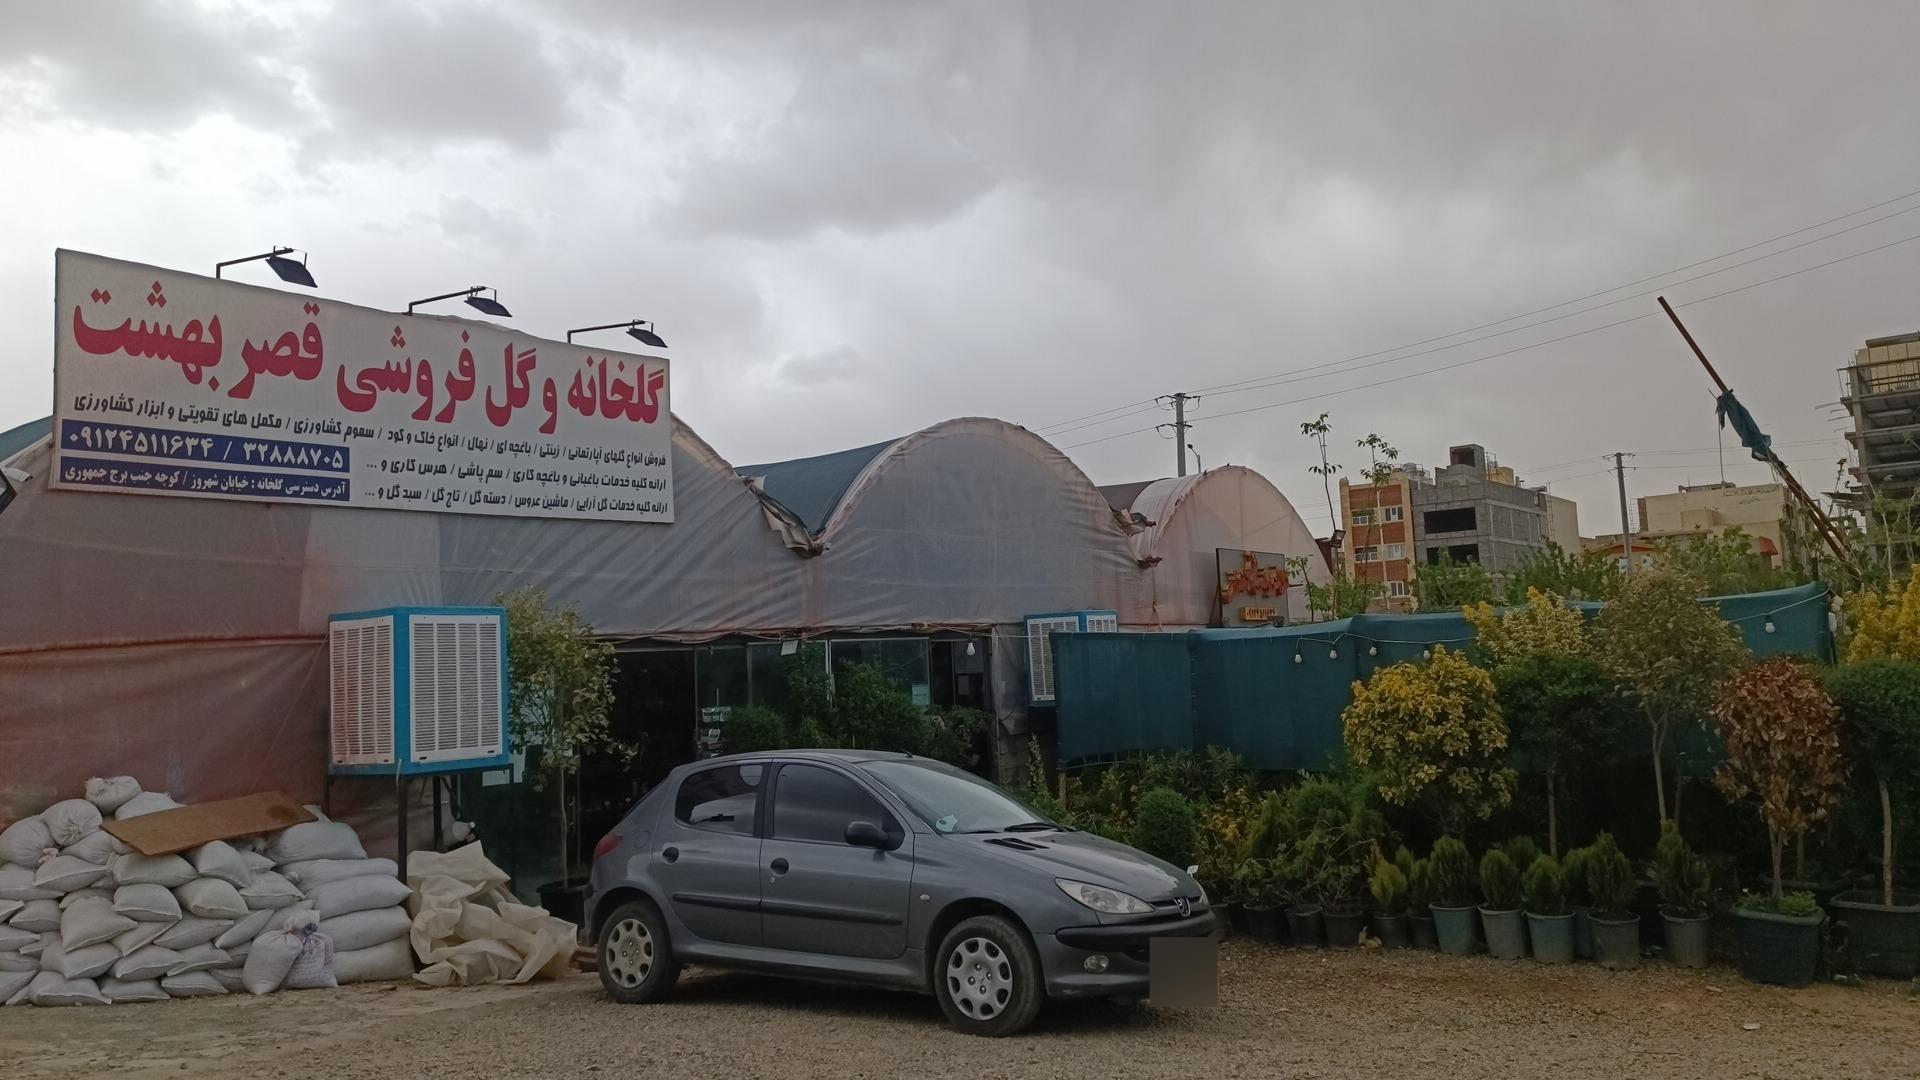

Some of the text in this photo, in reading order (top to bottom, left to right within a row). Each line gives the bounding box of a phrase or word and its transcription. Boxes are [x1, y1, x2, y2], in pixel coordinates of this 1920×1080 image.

[73, 280, 664, 434] گلخانه و گل فروشی قصر بهشت
[74, 393, 134, 412] کشاورزی
[137, 400, 165, 418] ابزار
[168, 408, 174, 419] و
[178, 405, 220, 424] تقویتی
[222, 410, 247, 426] های
[251, 413, 281, 429] مکمل
[294, 418, 341, 434] کشاورزی
[343, 425, 374, 442] سموم
[388, 429, 404, 443] کود
[407, 432, 411, 441] و
[415, 431, 435, 444] خاک
[438, 434, 458, 452] انواع
[70, 426, 214, 458] ۰۹۱۲۴۵۱۱۶۳۴
[243, 441, 344, 469] ۳۲۸۸۸۷۰۵
[467, 437, 488, 452] نهال
[497, 440, 507, 454] ای
[509, 441, 531, 458] باغچه
[540, 444, 560, 459] زینتی
[568, 446, 602, 464] آپارتمانی
[604, 450, 625, 463] گلهای
[626, 452, 643, 468] انواع
[644, 451, 666, 466] فروش
[381, 460, 387, 472] و
[391, 459, 415, 473] کاری
[418, 463, 447, 475] هرس
[458, 461, 483, 482] پاشی
[65, 466, 107, 482] جمهوری
[109, 469, 128, 484] برج
[130, 469, 152, 485] جنب
[155, 470, 180, 488] کوچه
[485, 468, 502, 484] سم
[513, 469, 534, 482] کاری
[536, 470, 560, 487] باغچه
[562, 475, 567, 484] و
[570, 472, 598, 488] باغبانی
[602, 475, 630, 487] خدمات
[220, 475, 248, 492] خیابان
[257, 478, 284, 490] گلخانه
[285, 483, 319, 497] دسترسی
[321, 481, 346, 497] آدرس
[632, 478, 647, 491] کلیه
[378, 487, 383, 499] و
[387, 484, 400, 500] گل
[402, 488, 422, 502] سبد
[432, 487, 444, 503] گل
[446, 490, 460, 508] تاج
[469, 490, 481, 505] گل
[484, 492, 506, 504] دسته
[515, 496, 540, 508] عروس
[542, 493, 568, 510] ماشین
[576, 496, 596, 511] آرایی
[598, 498, 607, 511] گل
[610, 499, 634, 511] خدمات
[636, 500, 651, 514] کلیه
